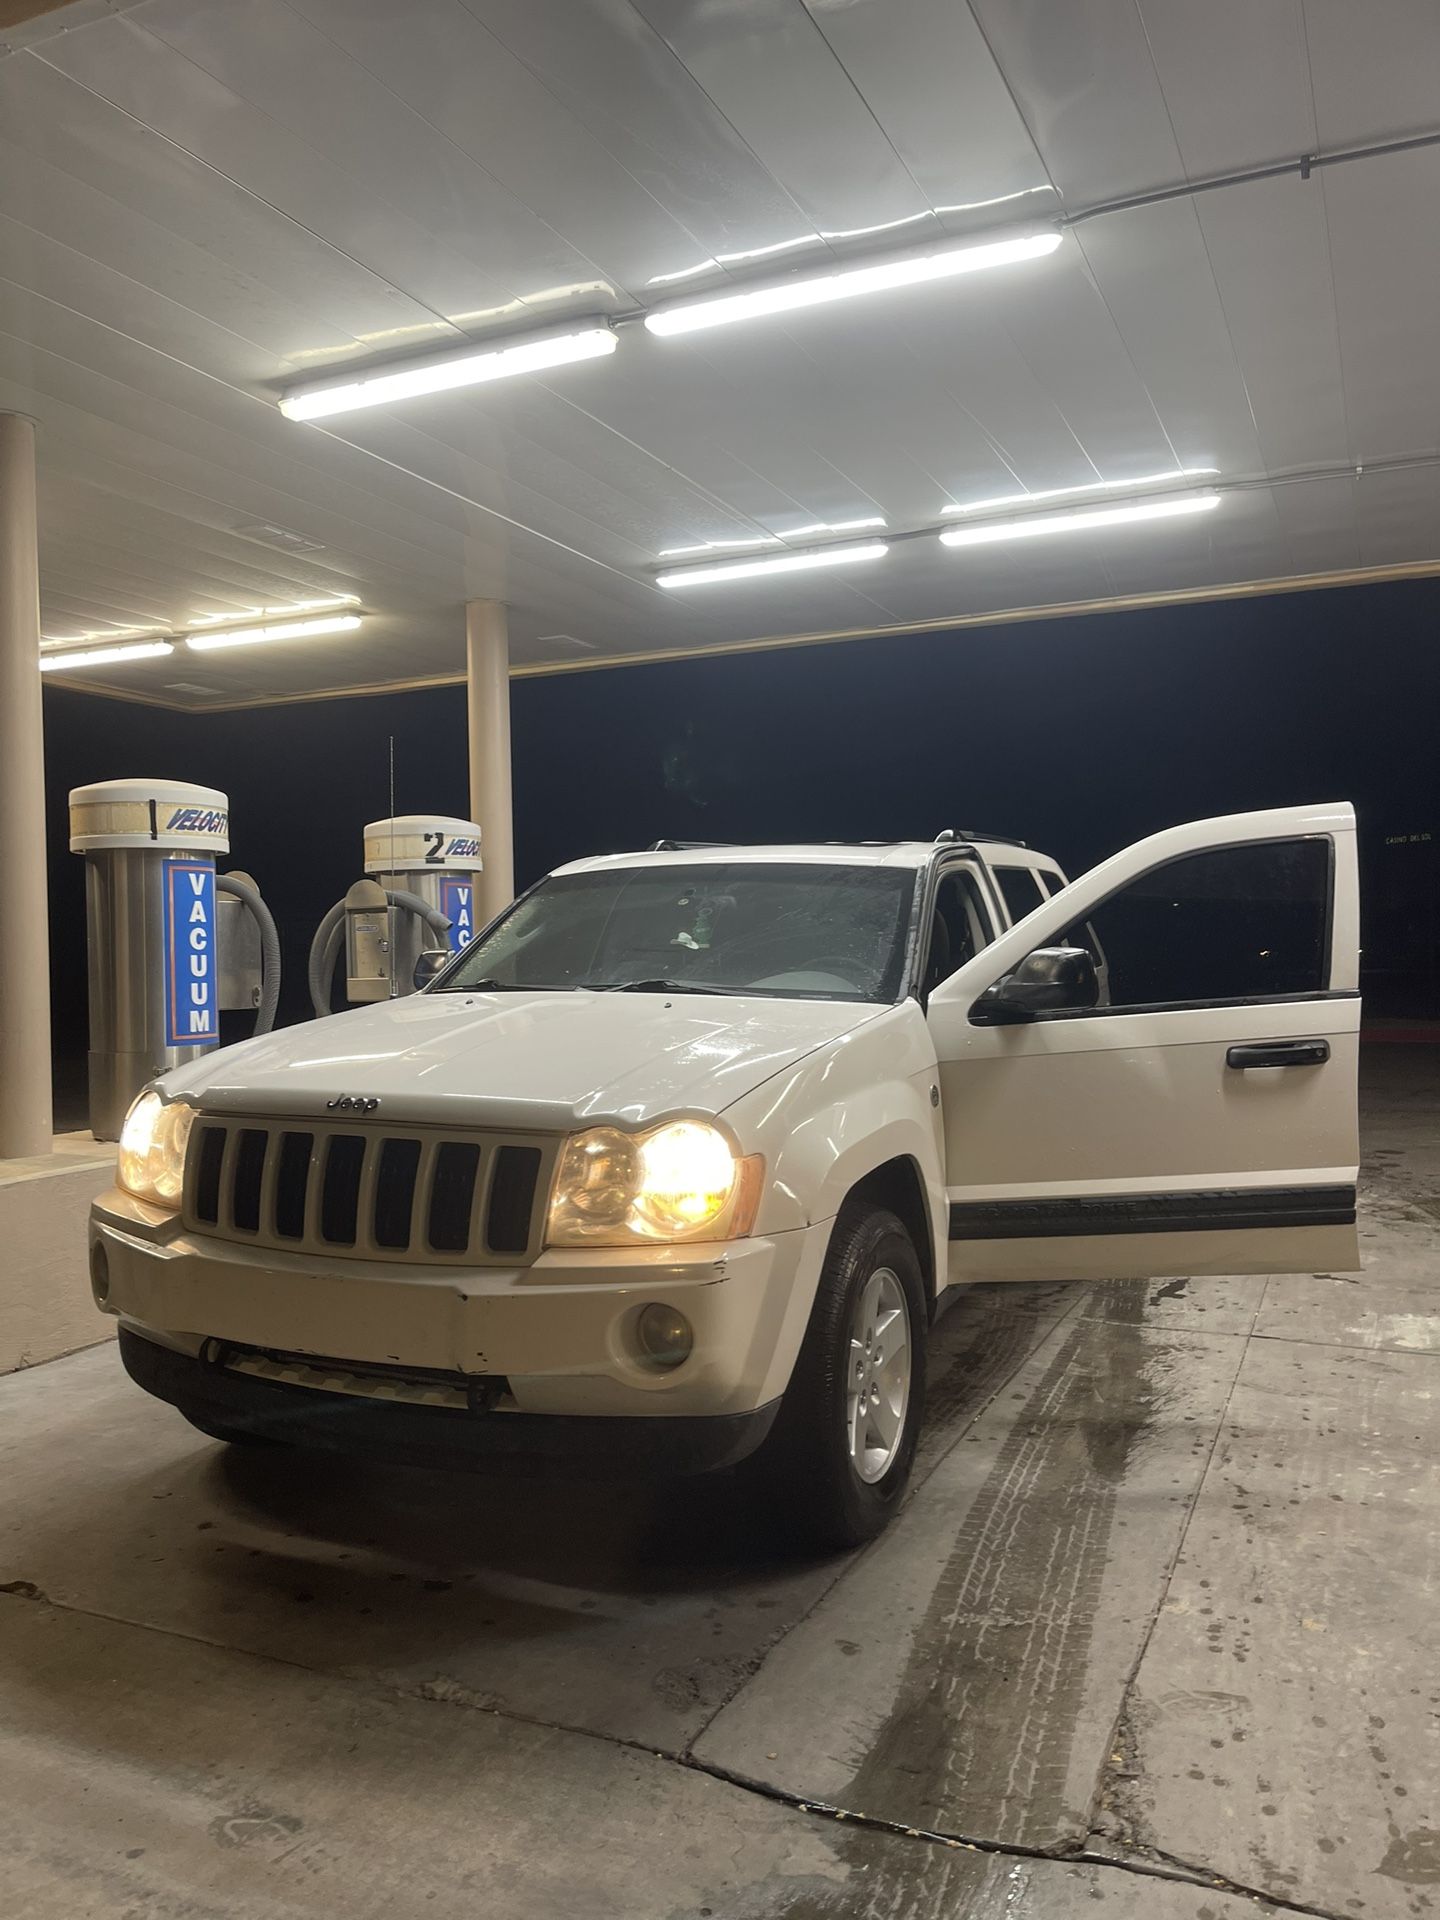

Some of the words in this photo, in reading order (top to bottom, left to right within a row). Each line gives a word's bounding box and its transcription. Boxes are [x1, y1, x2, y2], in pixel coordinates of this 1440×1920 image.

[424, 832, 445, 864] 2
[188, 873, 210, 1033] VACUUM
[326, 1093, 382, 1114] Jeep
